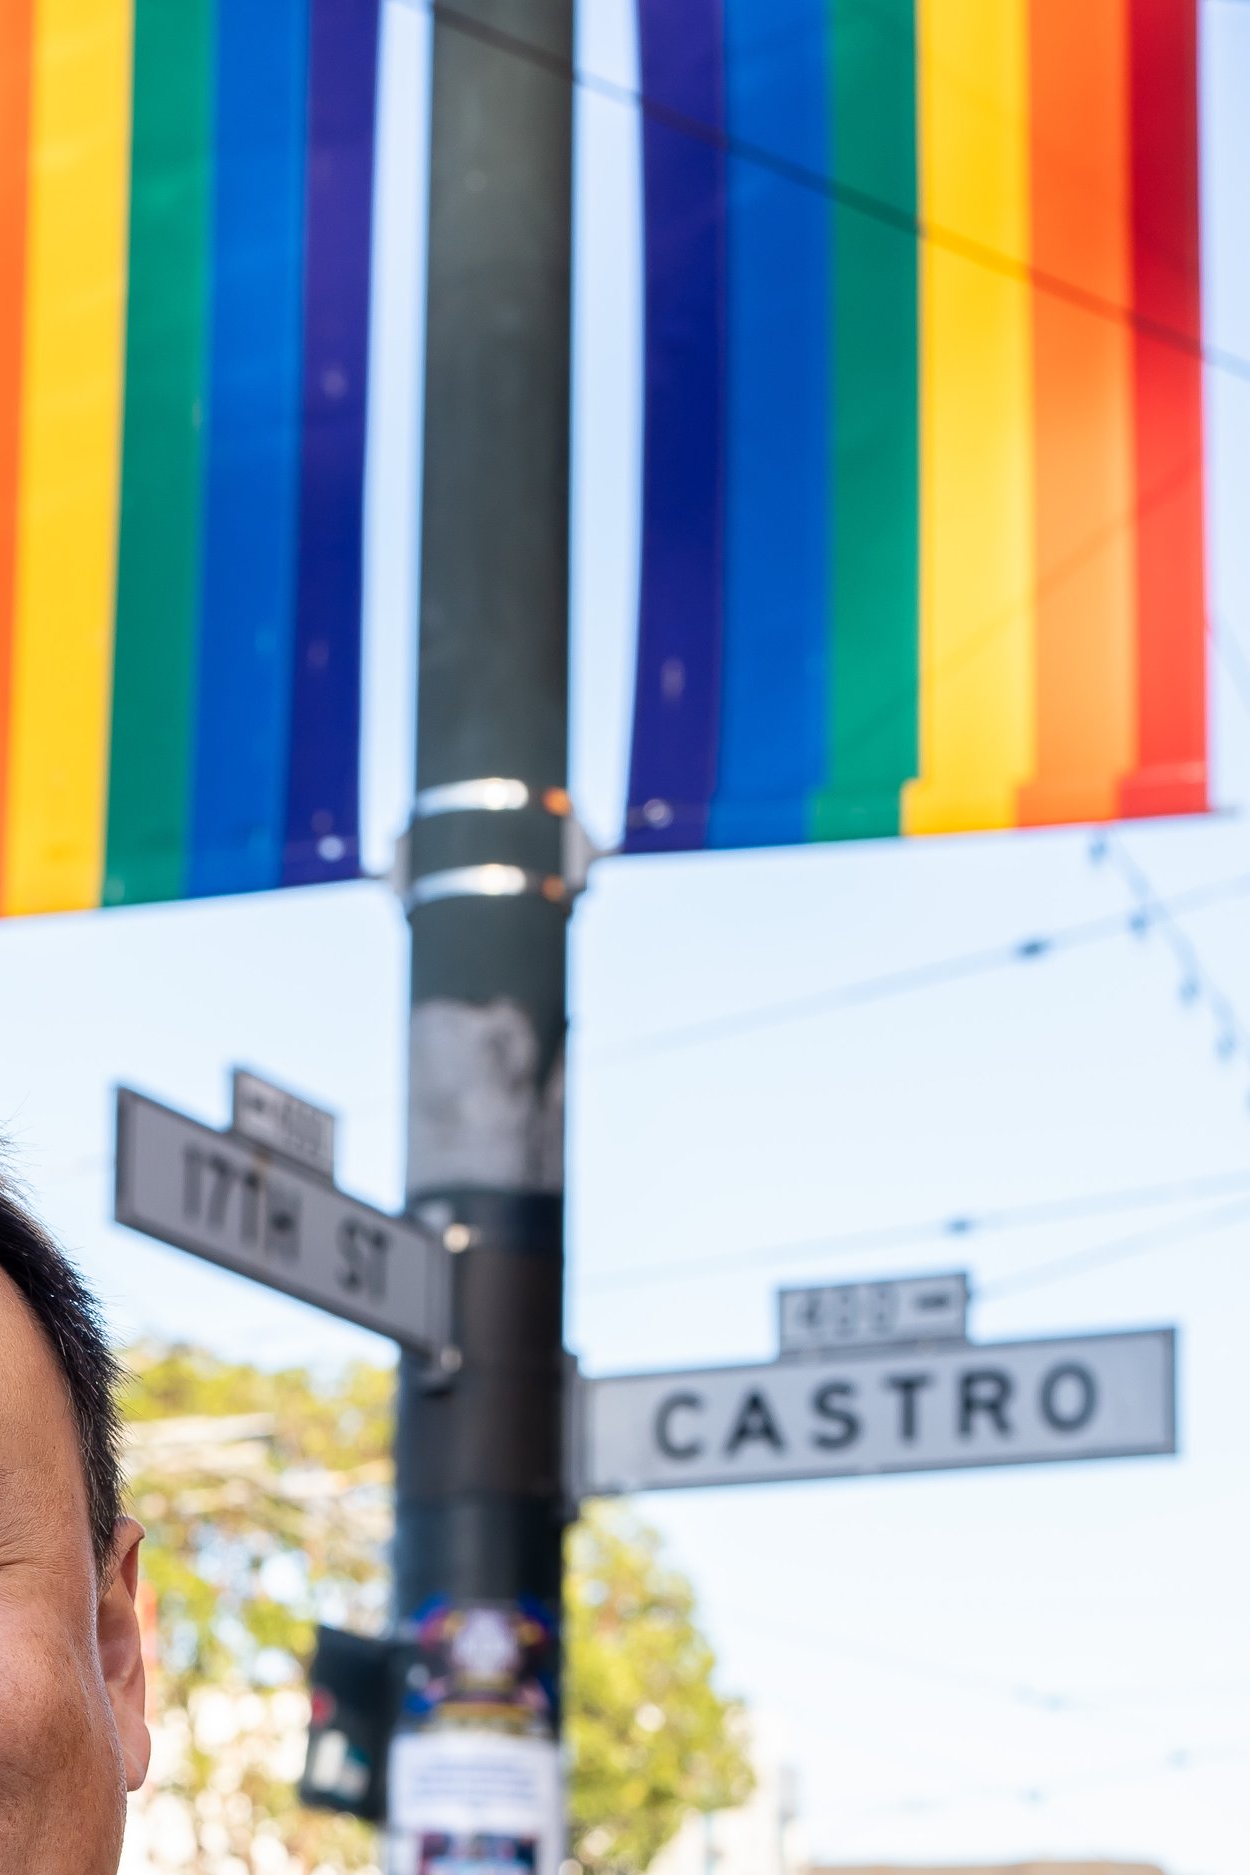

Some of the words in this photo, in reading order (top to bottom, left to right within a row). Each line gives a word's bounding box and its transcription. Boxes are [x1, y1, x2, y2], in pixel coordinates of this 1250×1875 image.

[183, 1144, 303, 1264] 17TH
[336, 1217, 390, 1303] ST
[654, 1361, 1098, 1462] CASTRO
